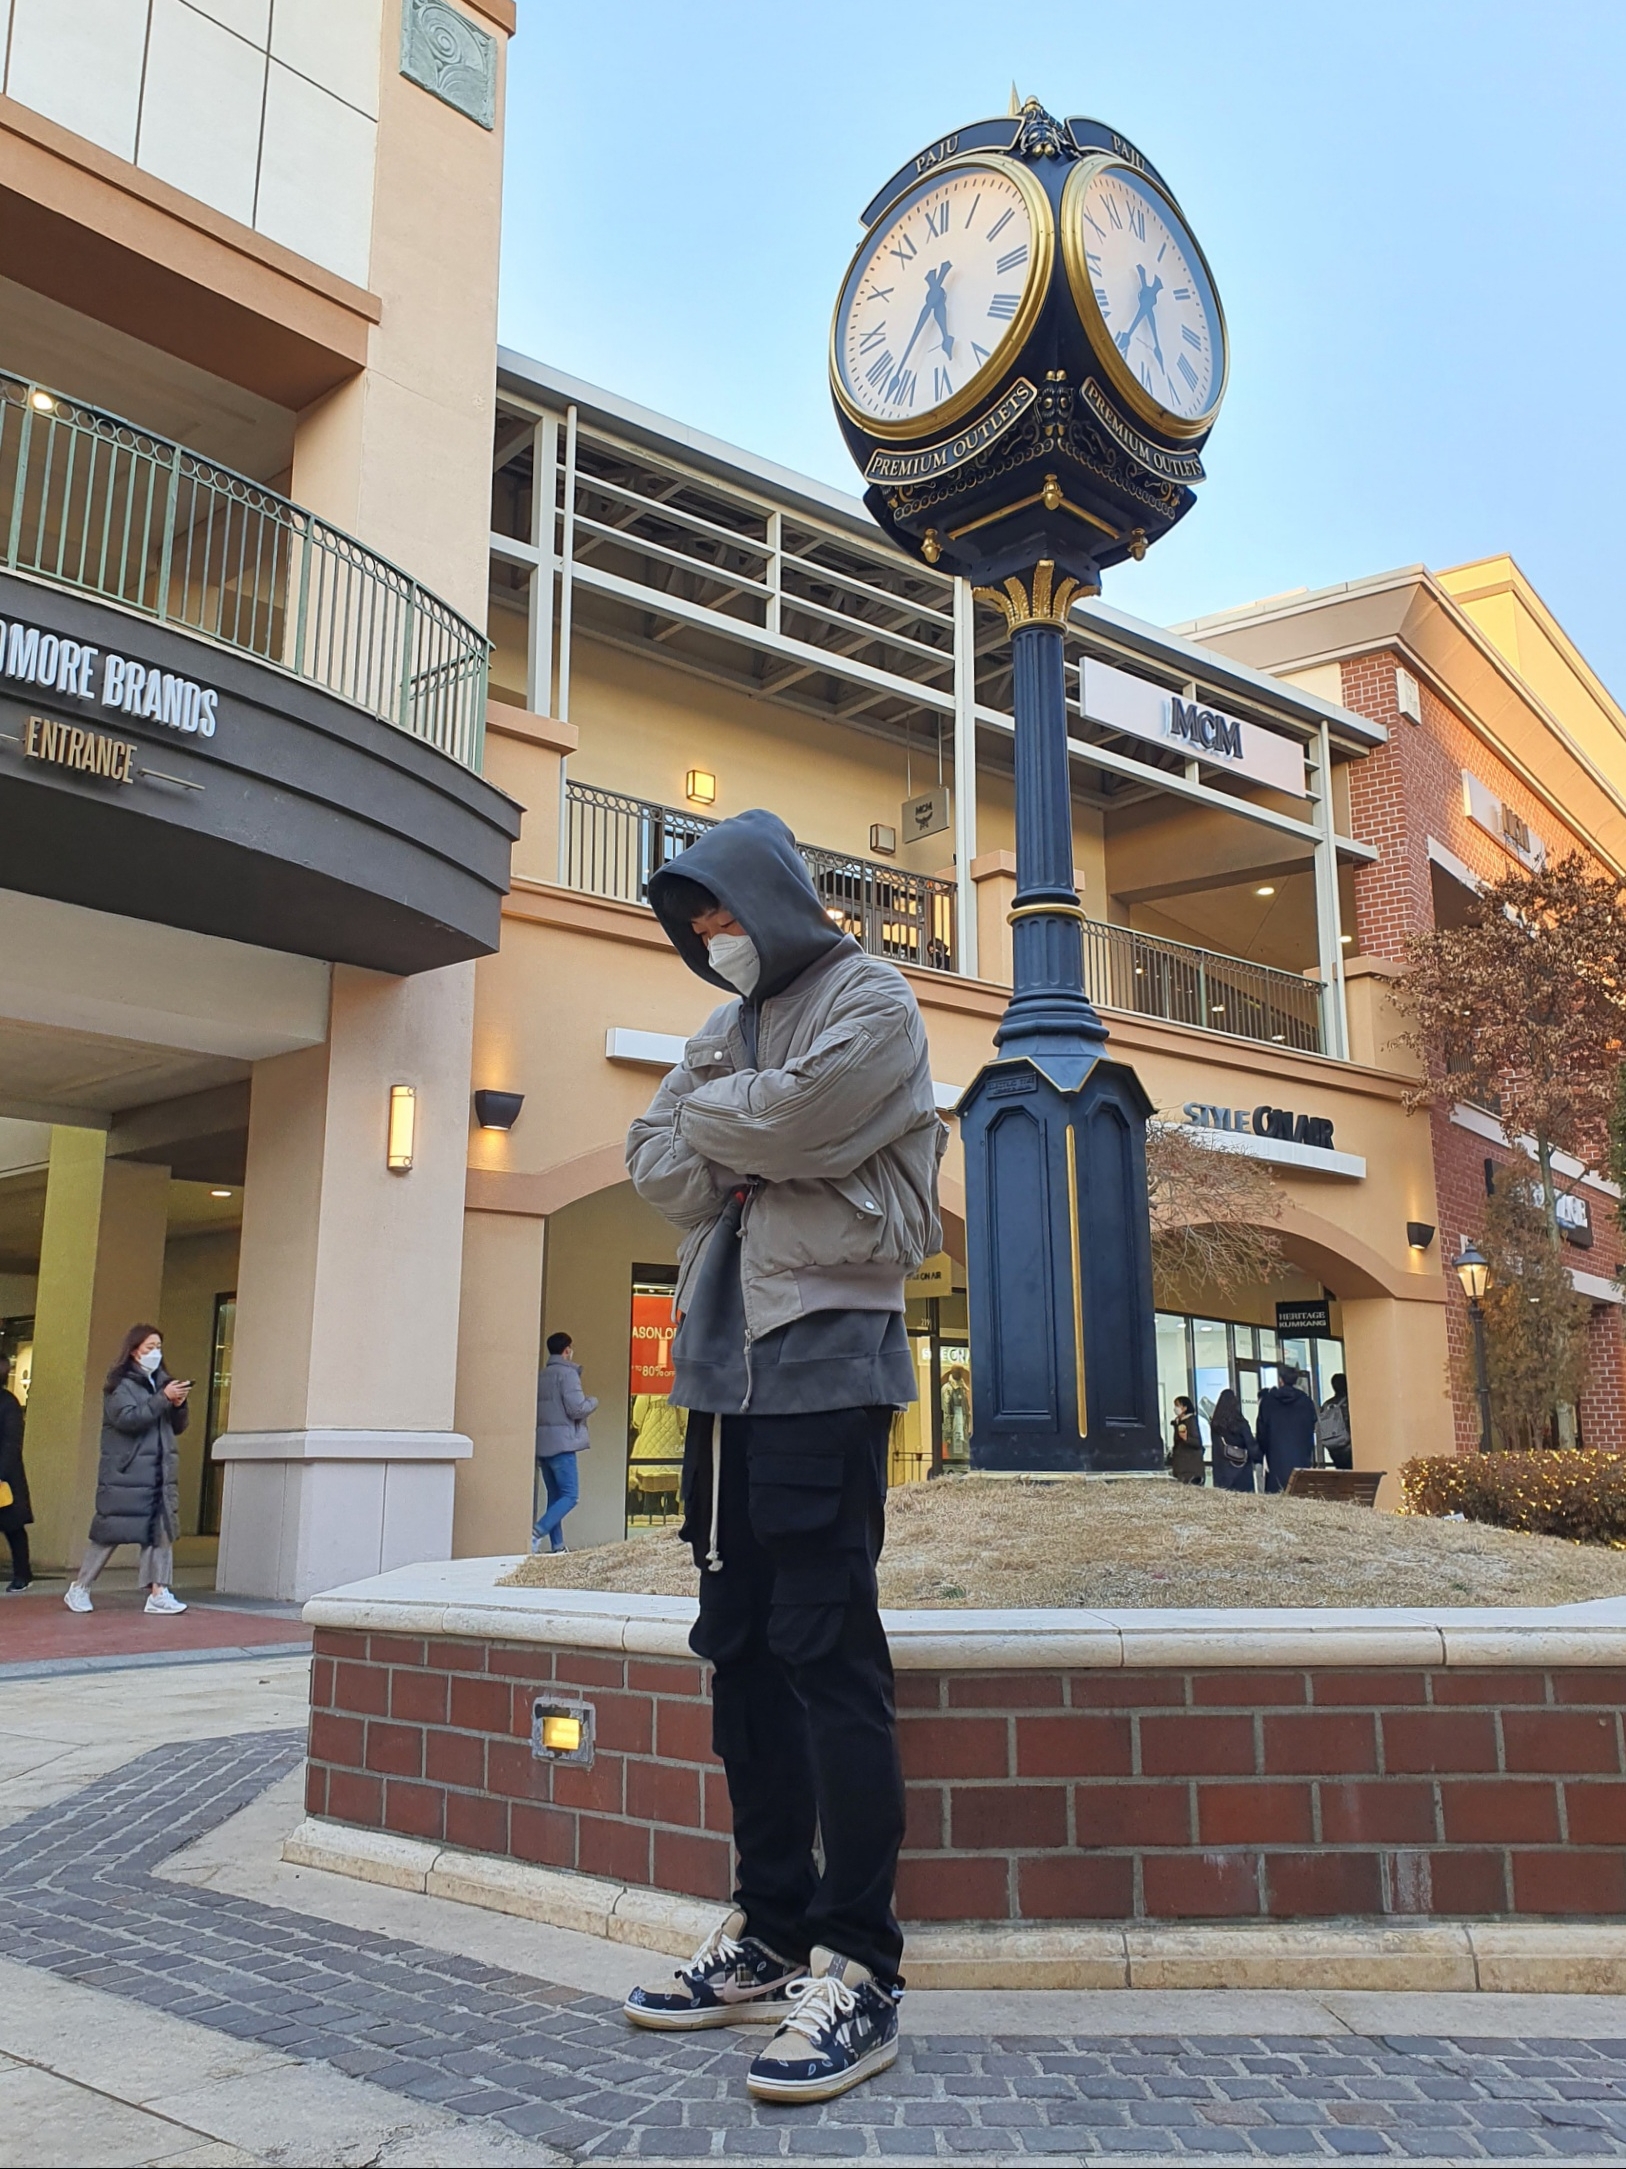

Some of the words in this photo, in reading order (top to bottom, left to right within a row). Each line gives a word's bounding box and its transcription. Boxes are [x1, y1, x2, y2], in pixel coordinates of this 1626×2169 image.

[915, 135, 960, 173] PAJU
[1112, 134, 1146, 171] PAJU
[924, 199, 950, 244] XII
[965, 193, 981, 230] I
[986, 207, 1015, 242] II
[1126, 200, 1146, 243] XII
[889, 233, 918, 271] XI
[996, 244, 1029, 275] III
[866, 285, 895, 303] X
[870, 449, 948, 477] PREMIUM
[953, 386, 1030, 457] OUTLETS
[1088, 384, 1150, 462] PREMIUM
[1153, 452, 1202, 476] OUTLETS
[0, 619, 98, 700] MORE
[101, 653, 219, 738] BRANDS
[1170, 696, 1243, 759] MCM
[26, 716, 137, 784] ENTRANCE
[1183, 1102, 1251, 1133] STYLE
[1252, 1105, 1294, 1143] ON
[1293, 1114, 1334, 1150] AIR
[920, 1271, 930, 1281] ON
[930, 1271, 942, 1280] AIR
[1279, 1311, 1326, 1320] HERITAGE
[1279, 1320, 1327, 1328] KUMKANG
[642, 1365, 664, 1377] 80%
